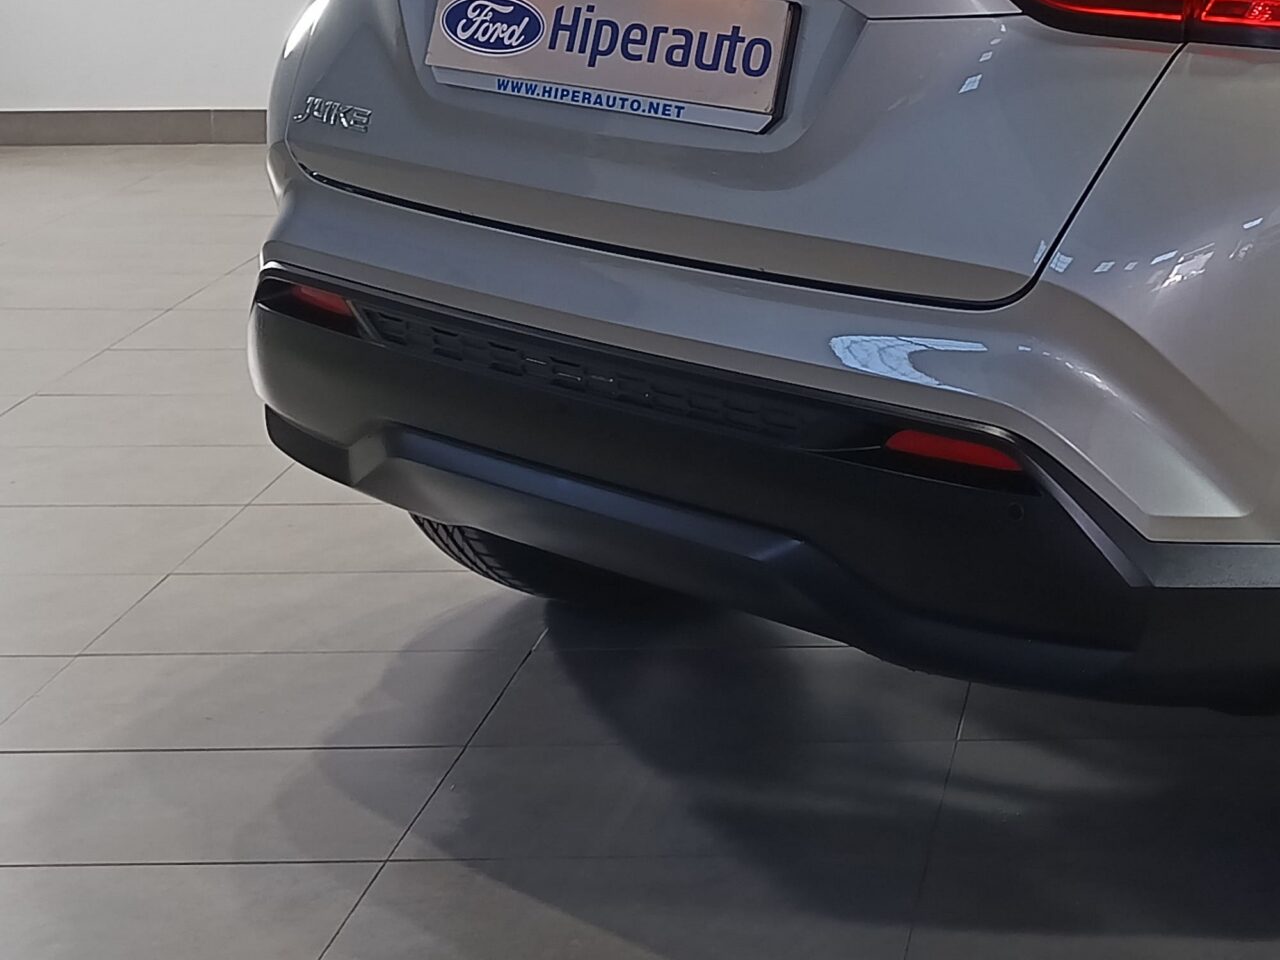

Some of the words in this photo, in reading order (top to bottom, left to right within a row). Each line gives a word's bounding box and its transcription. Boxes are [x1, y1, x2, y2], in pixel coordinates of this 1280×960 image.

[457, 0, 529, 47] Ford
[547, 5, 773, 78] Hiperauto
[496, 78, 686, 119] WWW.HIPERAUTO.NET
